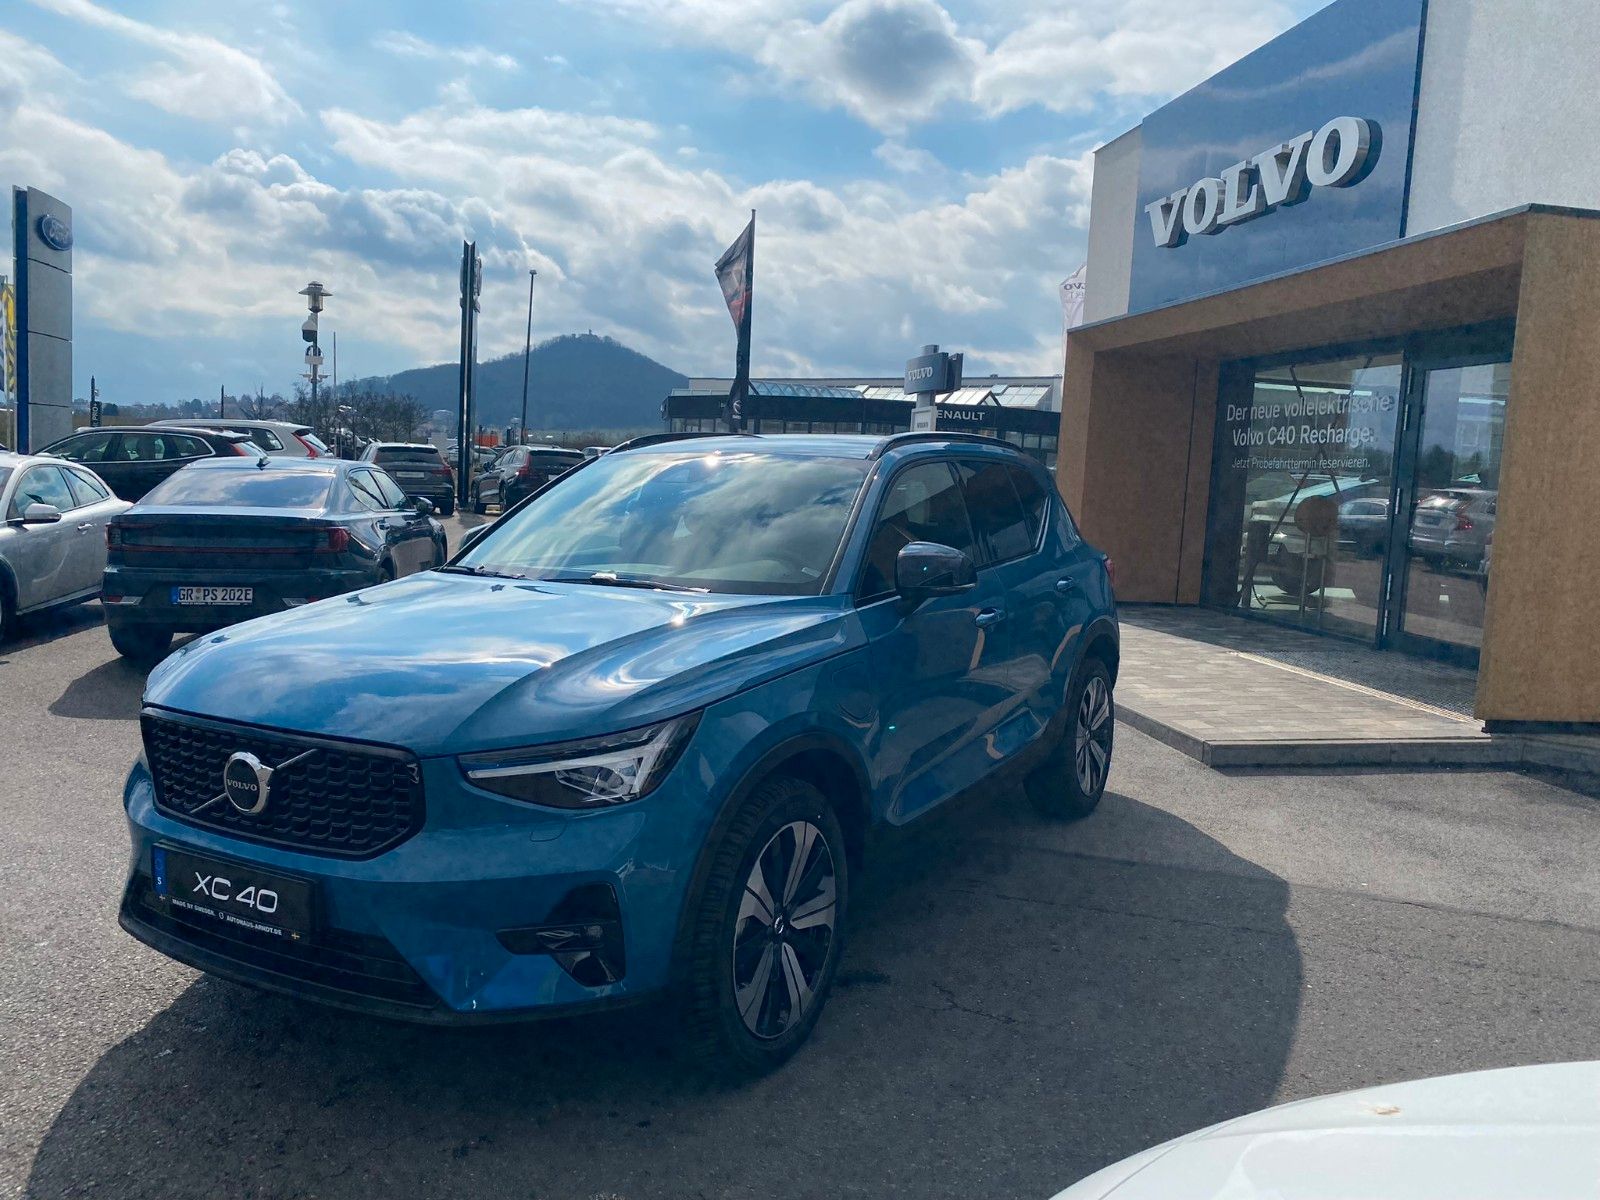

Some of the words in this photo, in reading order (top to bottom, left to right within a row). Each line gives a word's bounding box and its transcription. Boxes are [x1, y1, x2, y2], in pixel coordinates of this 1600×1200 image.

[1145, 116, 1368, 247] VOLVO
[908, 366, 933, 381] VOLVO
[1226, 404, 1248, 421] Der
[1250, 404, 1280, 420] neue
[1284, 392, 1391, 417] vollelektrische
[936, 409, 986, 420] ENAULT
[1232, 428, 1264, 446] Volvo
[1267, 425, 1296, 445] C40
[1300, 424, 1375, 448] Recharge.
[1232, 456, 1250, 469] Jetzt
[1251, 456, 1317, 470] Probefahrttermin
[1319, 456, 1371, 469] reservieren.
[178, 588, 194, 601] GR
[202, 588, 218, 601] PS
[221, 588, 252, 601] 202E
[226, 778, 258, 792] VOLVO
[157, 876, 162, 885] S
[192, 871, 232, 901] XC
[236, 886, 278, 913] 40
